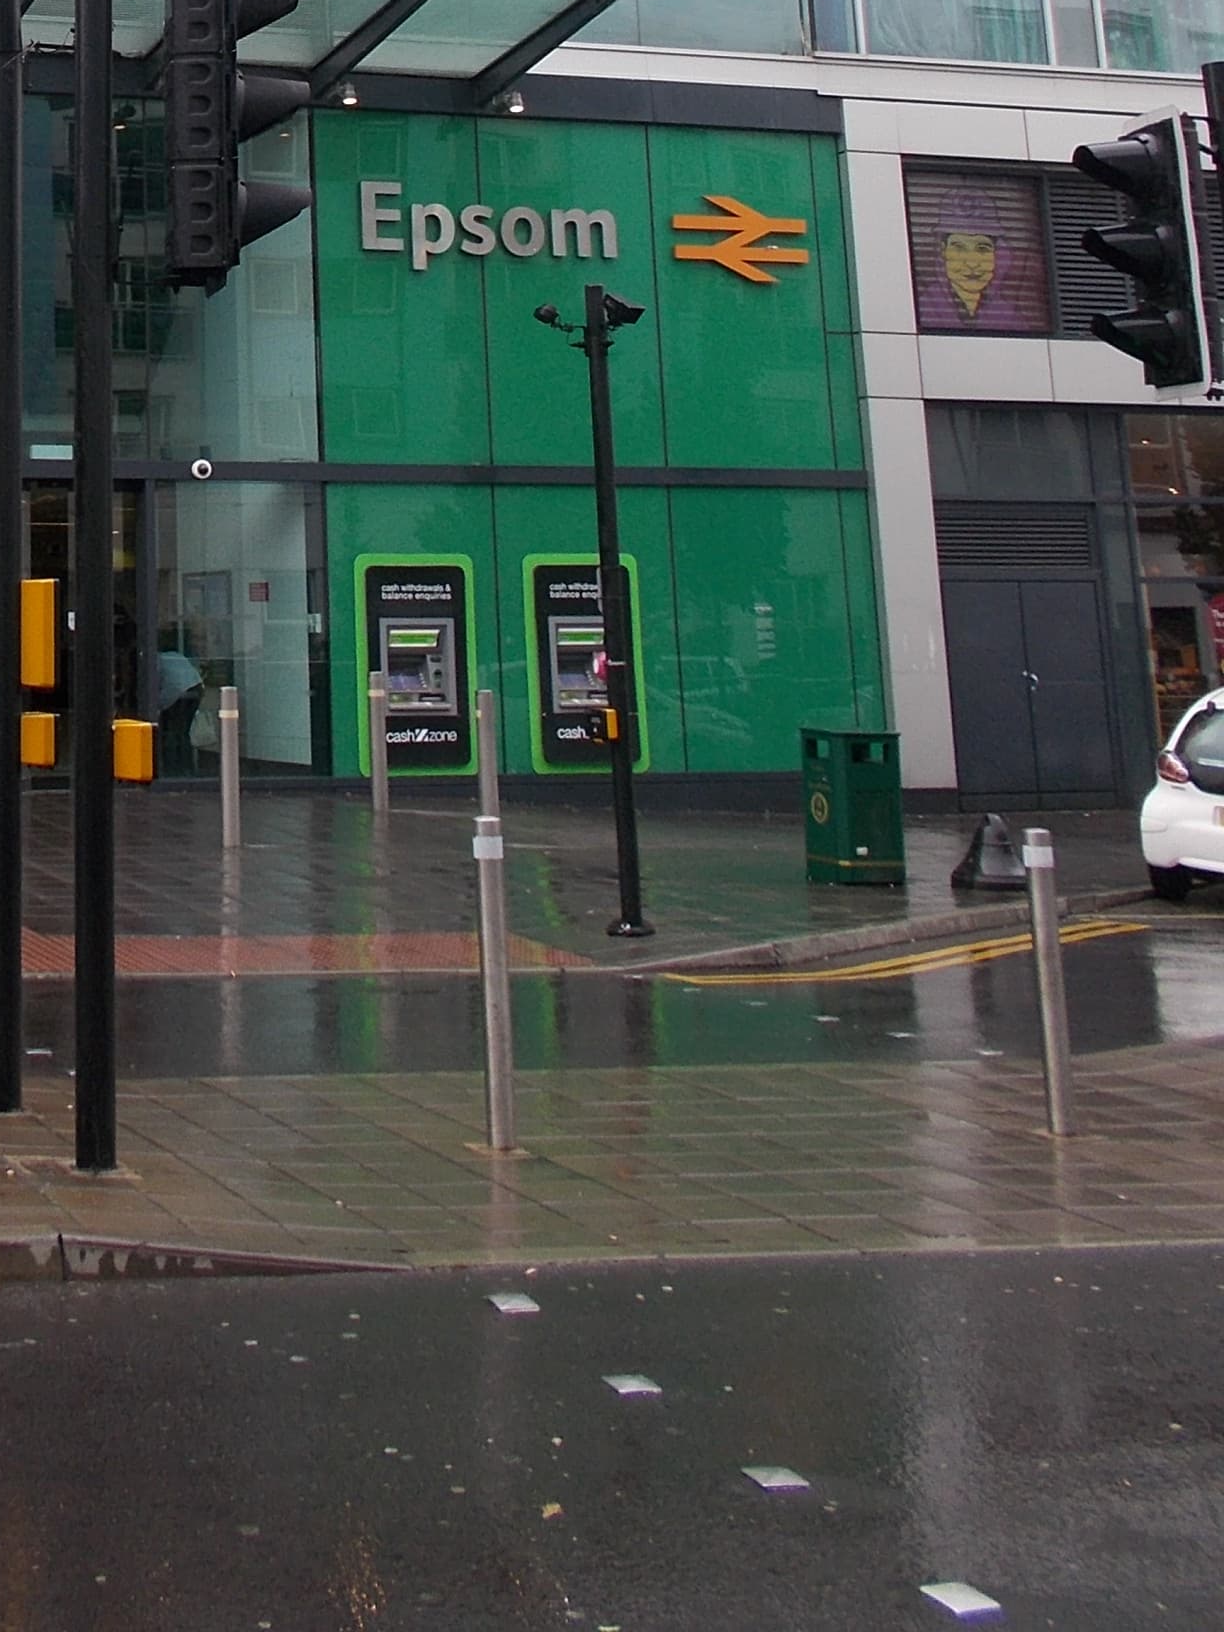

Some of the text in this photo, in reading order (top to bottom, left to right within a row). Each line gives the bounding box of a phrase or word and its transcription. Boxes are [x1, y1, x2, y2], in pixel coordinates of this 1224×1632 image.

[360, 180, 619, 271] Epsom
[381, 583, 452, 592] cash withdrawals &
[549, 582, 567, 591] cash
[381, 591, 452, 601] balance enquiries
[549, 590, 580, 599] balance
[385, 729, 458, 743] cash zone
[556, 726, 585, 740] cash
